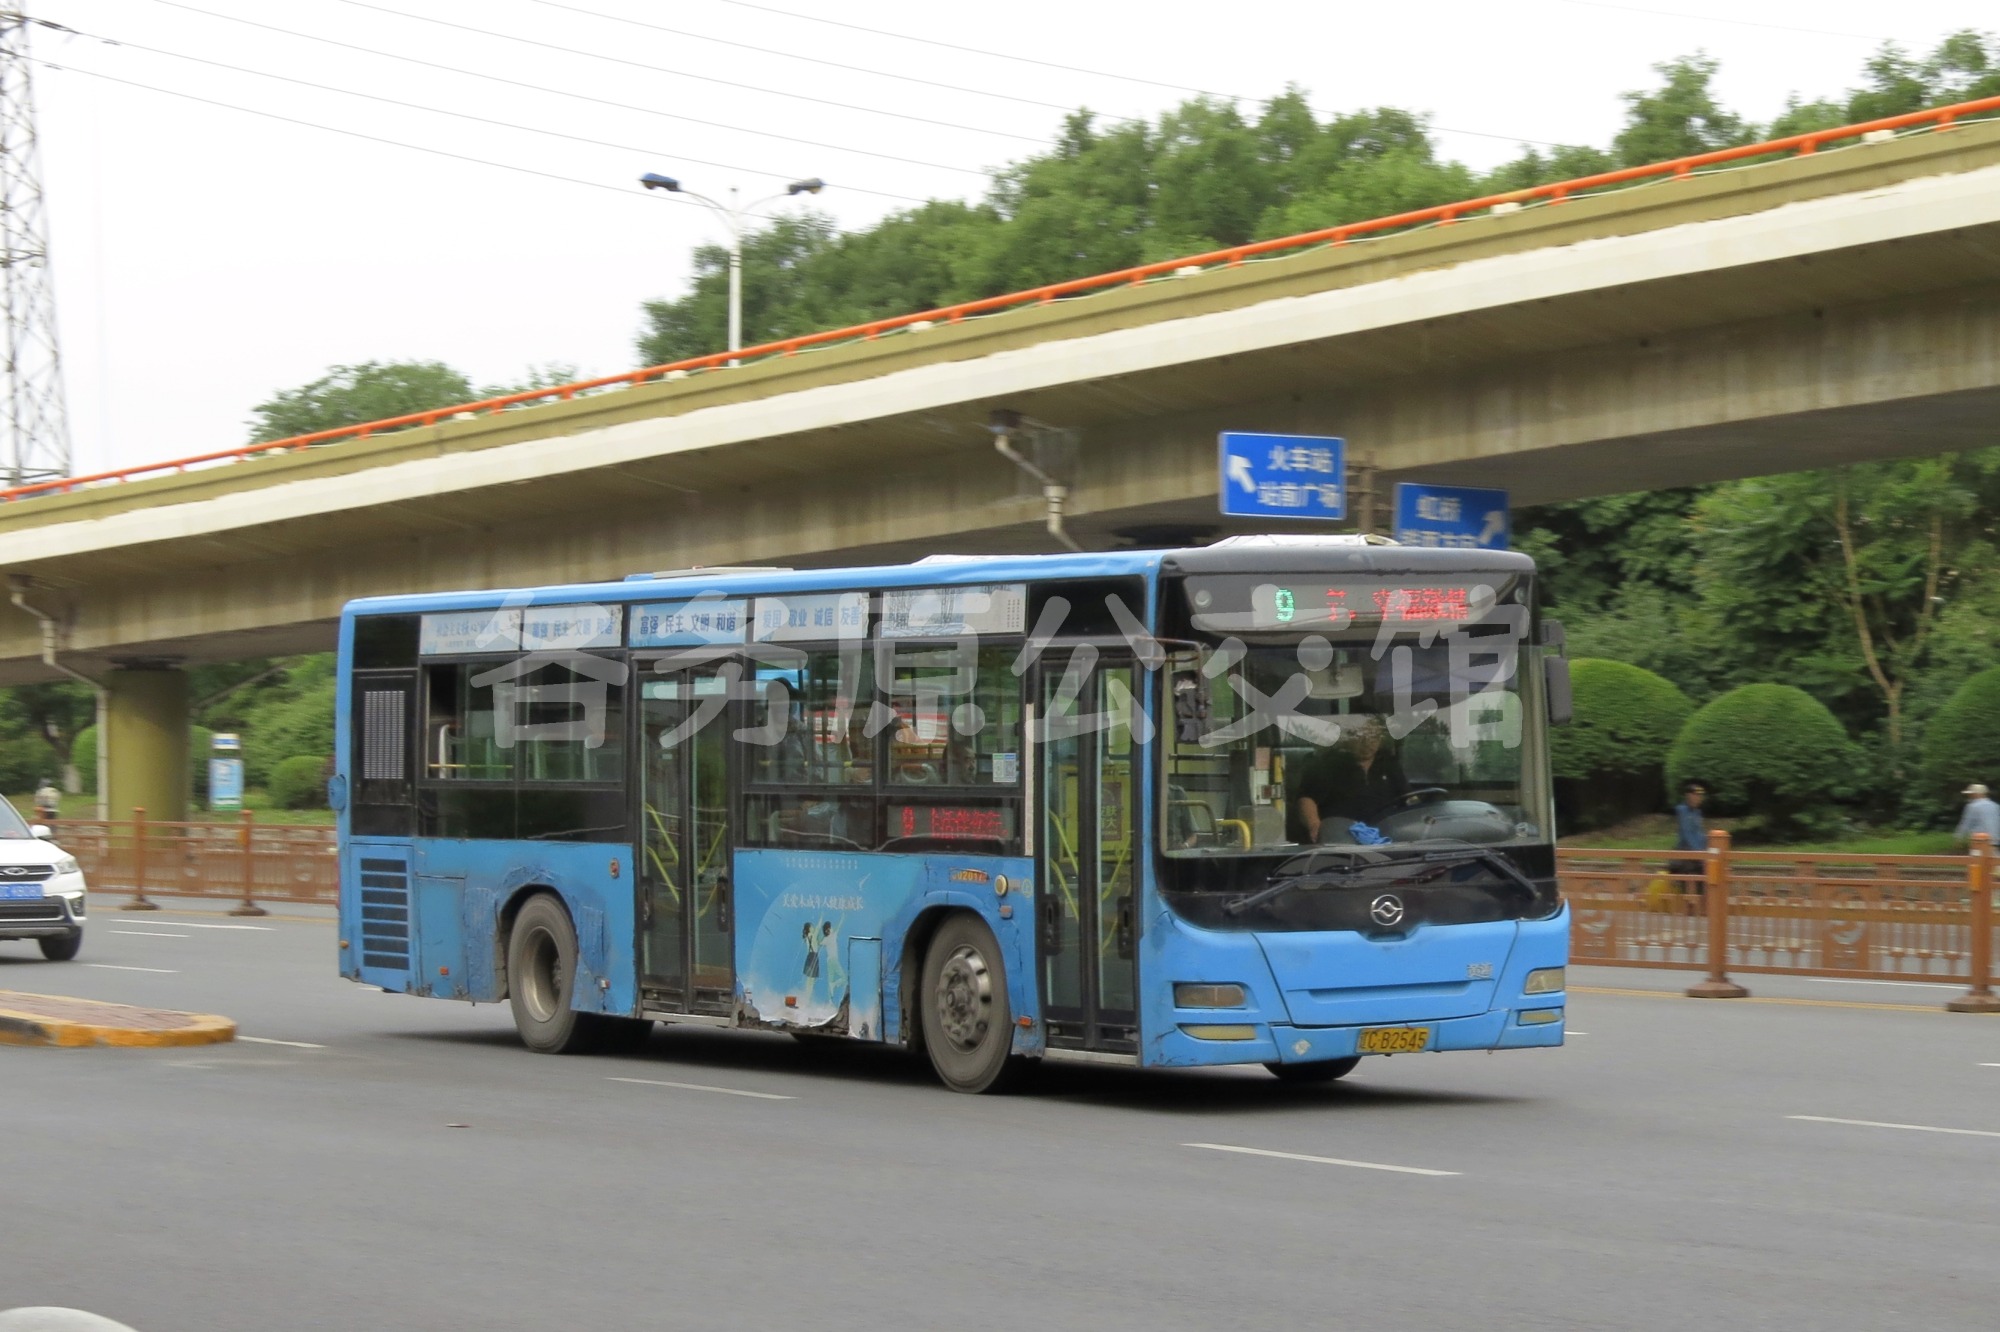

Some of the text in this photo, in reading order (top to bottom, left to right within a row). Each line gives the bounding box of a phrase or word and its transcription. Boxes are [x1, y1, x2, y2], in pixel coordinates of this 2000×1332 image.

[1267, 445, 1333, 473] 火车站
[1257, 481, 1341, 508] 站前广场
[763, 606, 860, 628] 爱国 敬业 诚信 友善
[1274, 588, 1295, 621] 9
[640, 612, 736, 634] 富强 民主 文明 和谐
